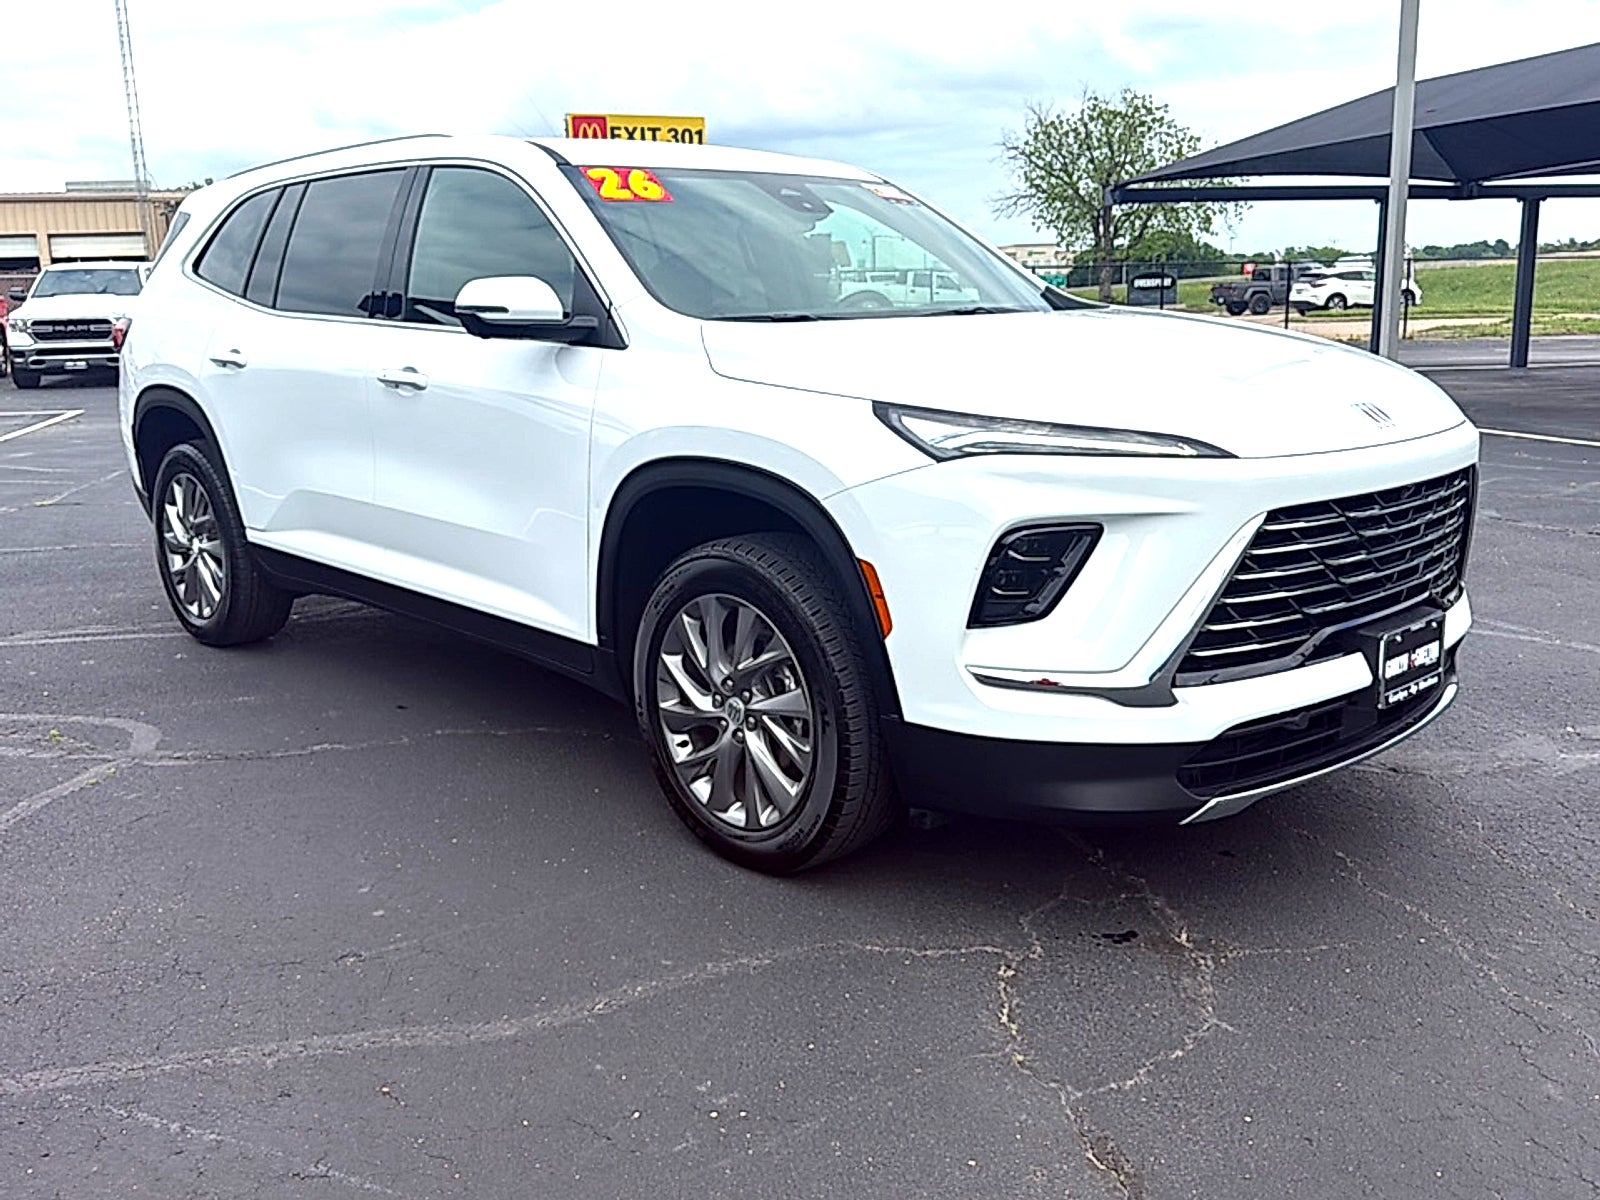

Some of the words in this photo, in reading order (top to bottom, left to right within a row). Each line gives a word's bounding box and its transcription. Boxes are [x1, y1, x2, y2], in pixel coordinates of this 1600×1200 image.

[610, 126, 661, 142] EXIT
[667, 128, 704, 145] 301
[586, 168, 665, 200] 26
